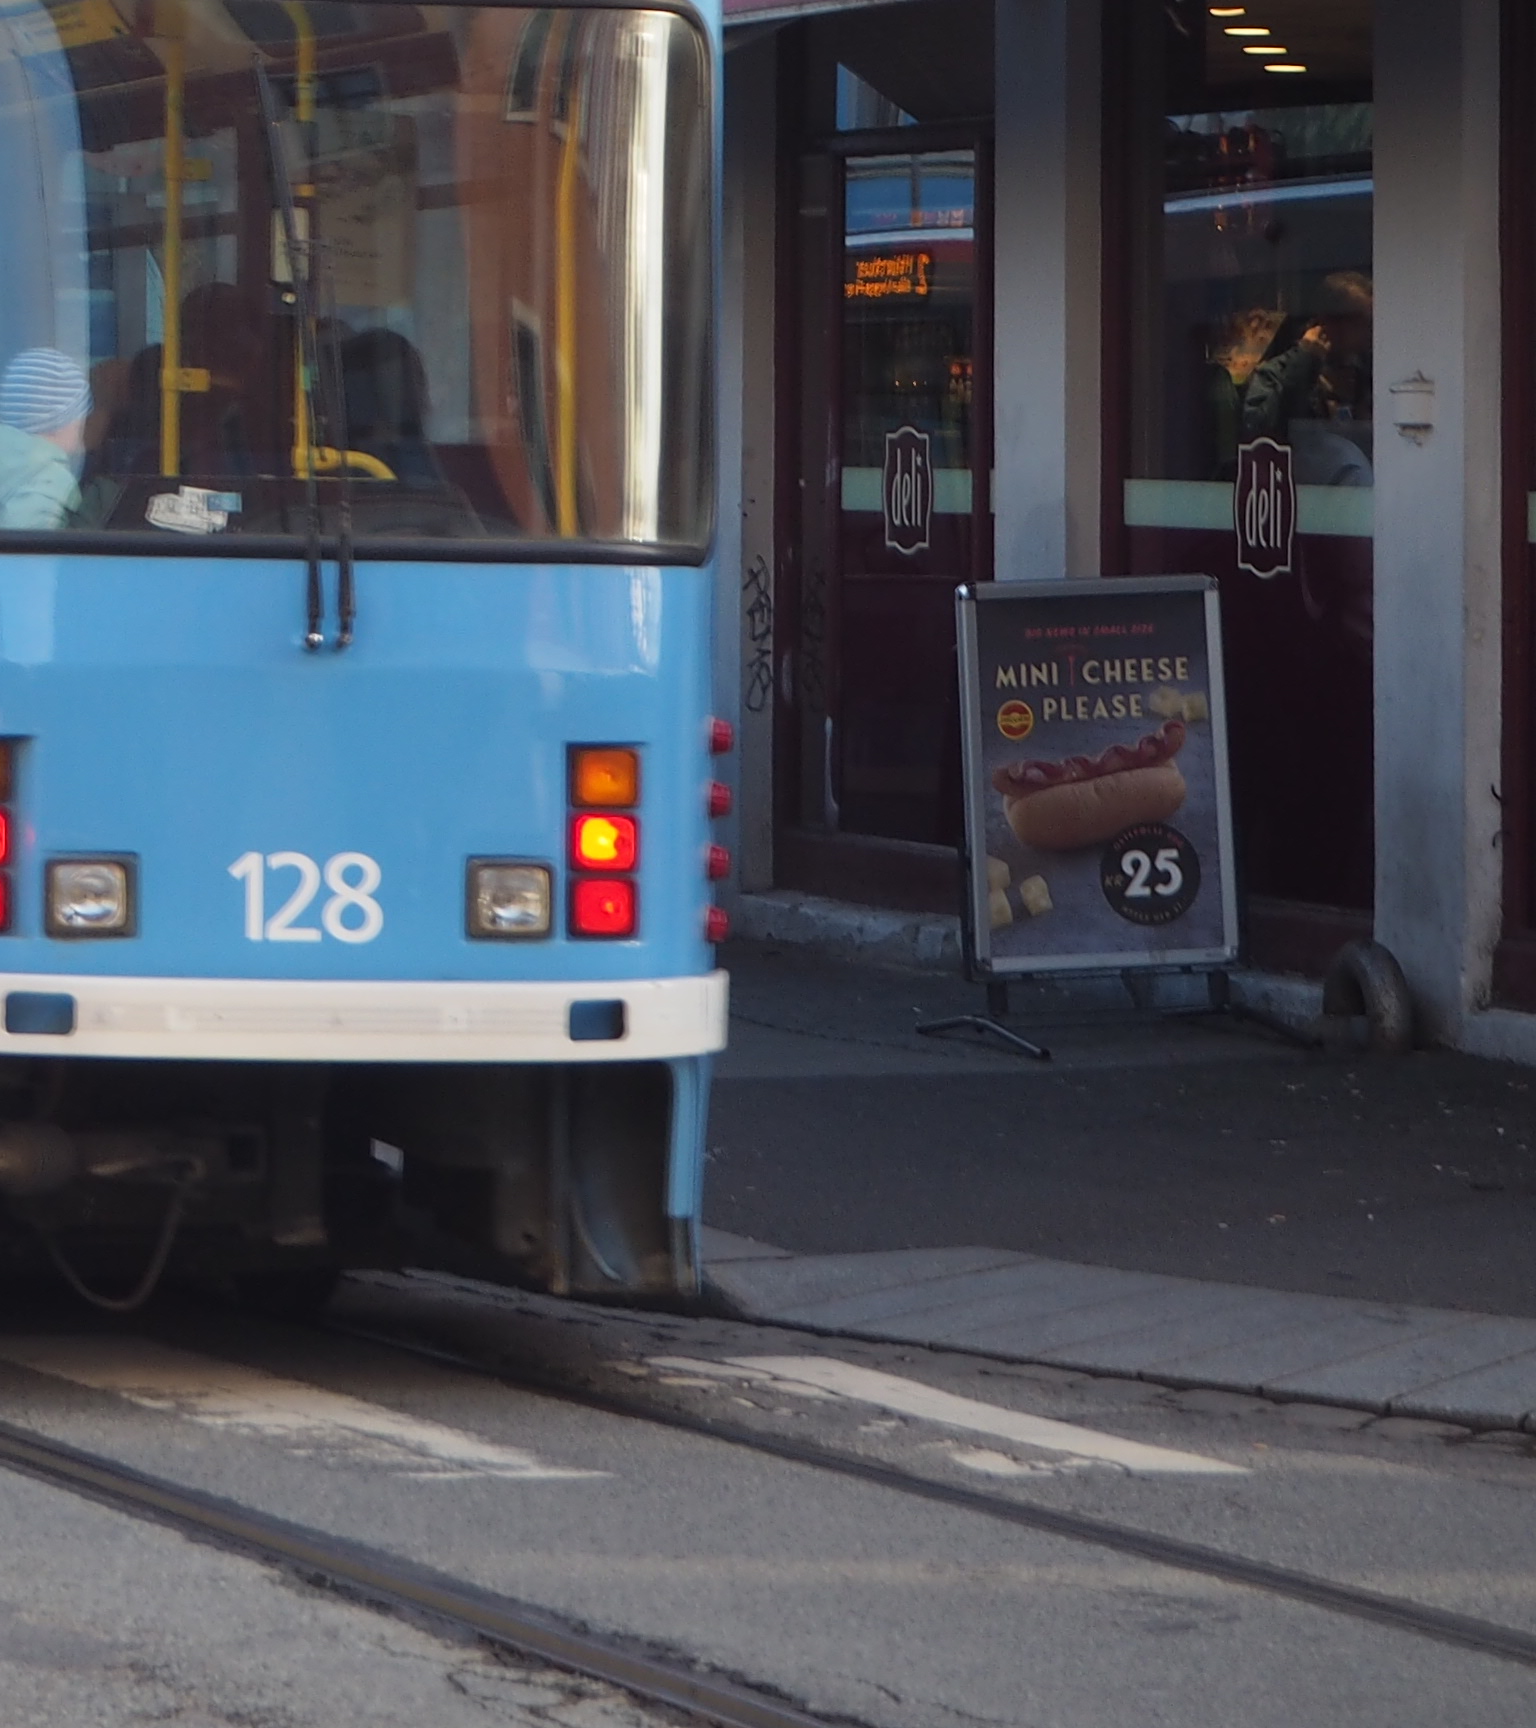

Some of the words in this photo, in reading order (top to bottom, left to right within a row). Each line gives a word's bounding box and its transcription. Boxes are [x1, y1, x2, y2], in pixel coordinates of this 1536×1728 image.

[892, 447, 922, 527] deli
[1245, 460, 1283, 548] deli
[995, 662, 1059, 689] MINI
[1081, 656, 1190, 685] CHEESE
[1043, 694, 1144, 722] PLEASE
[227, 851, 385, 944] 128
[1121, 848, 1183, 897] 25
